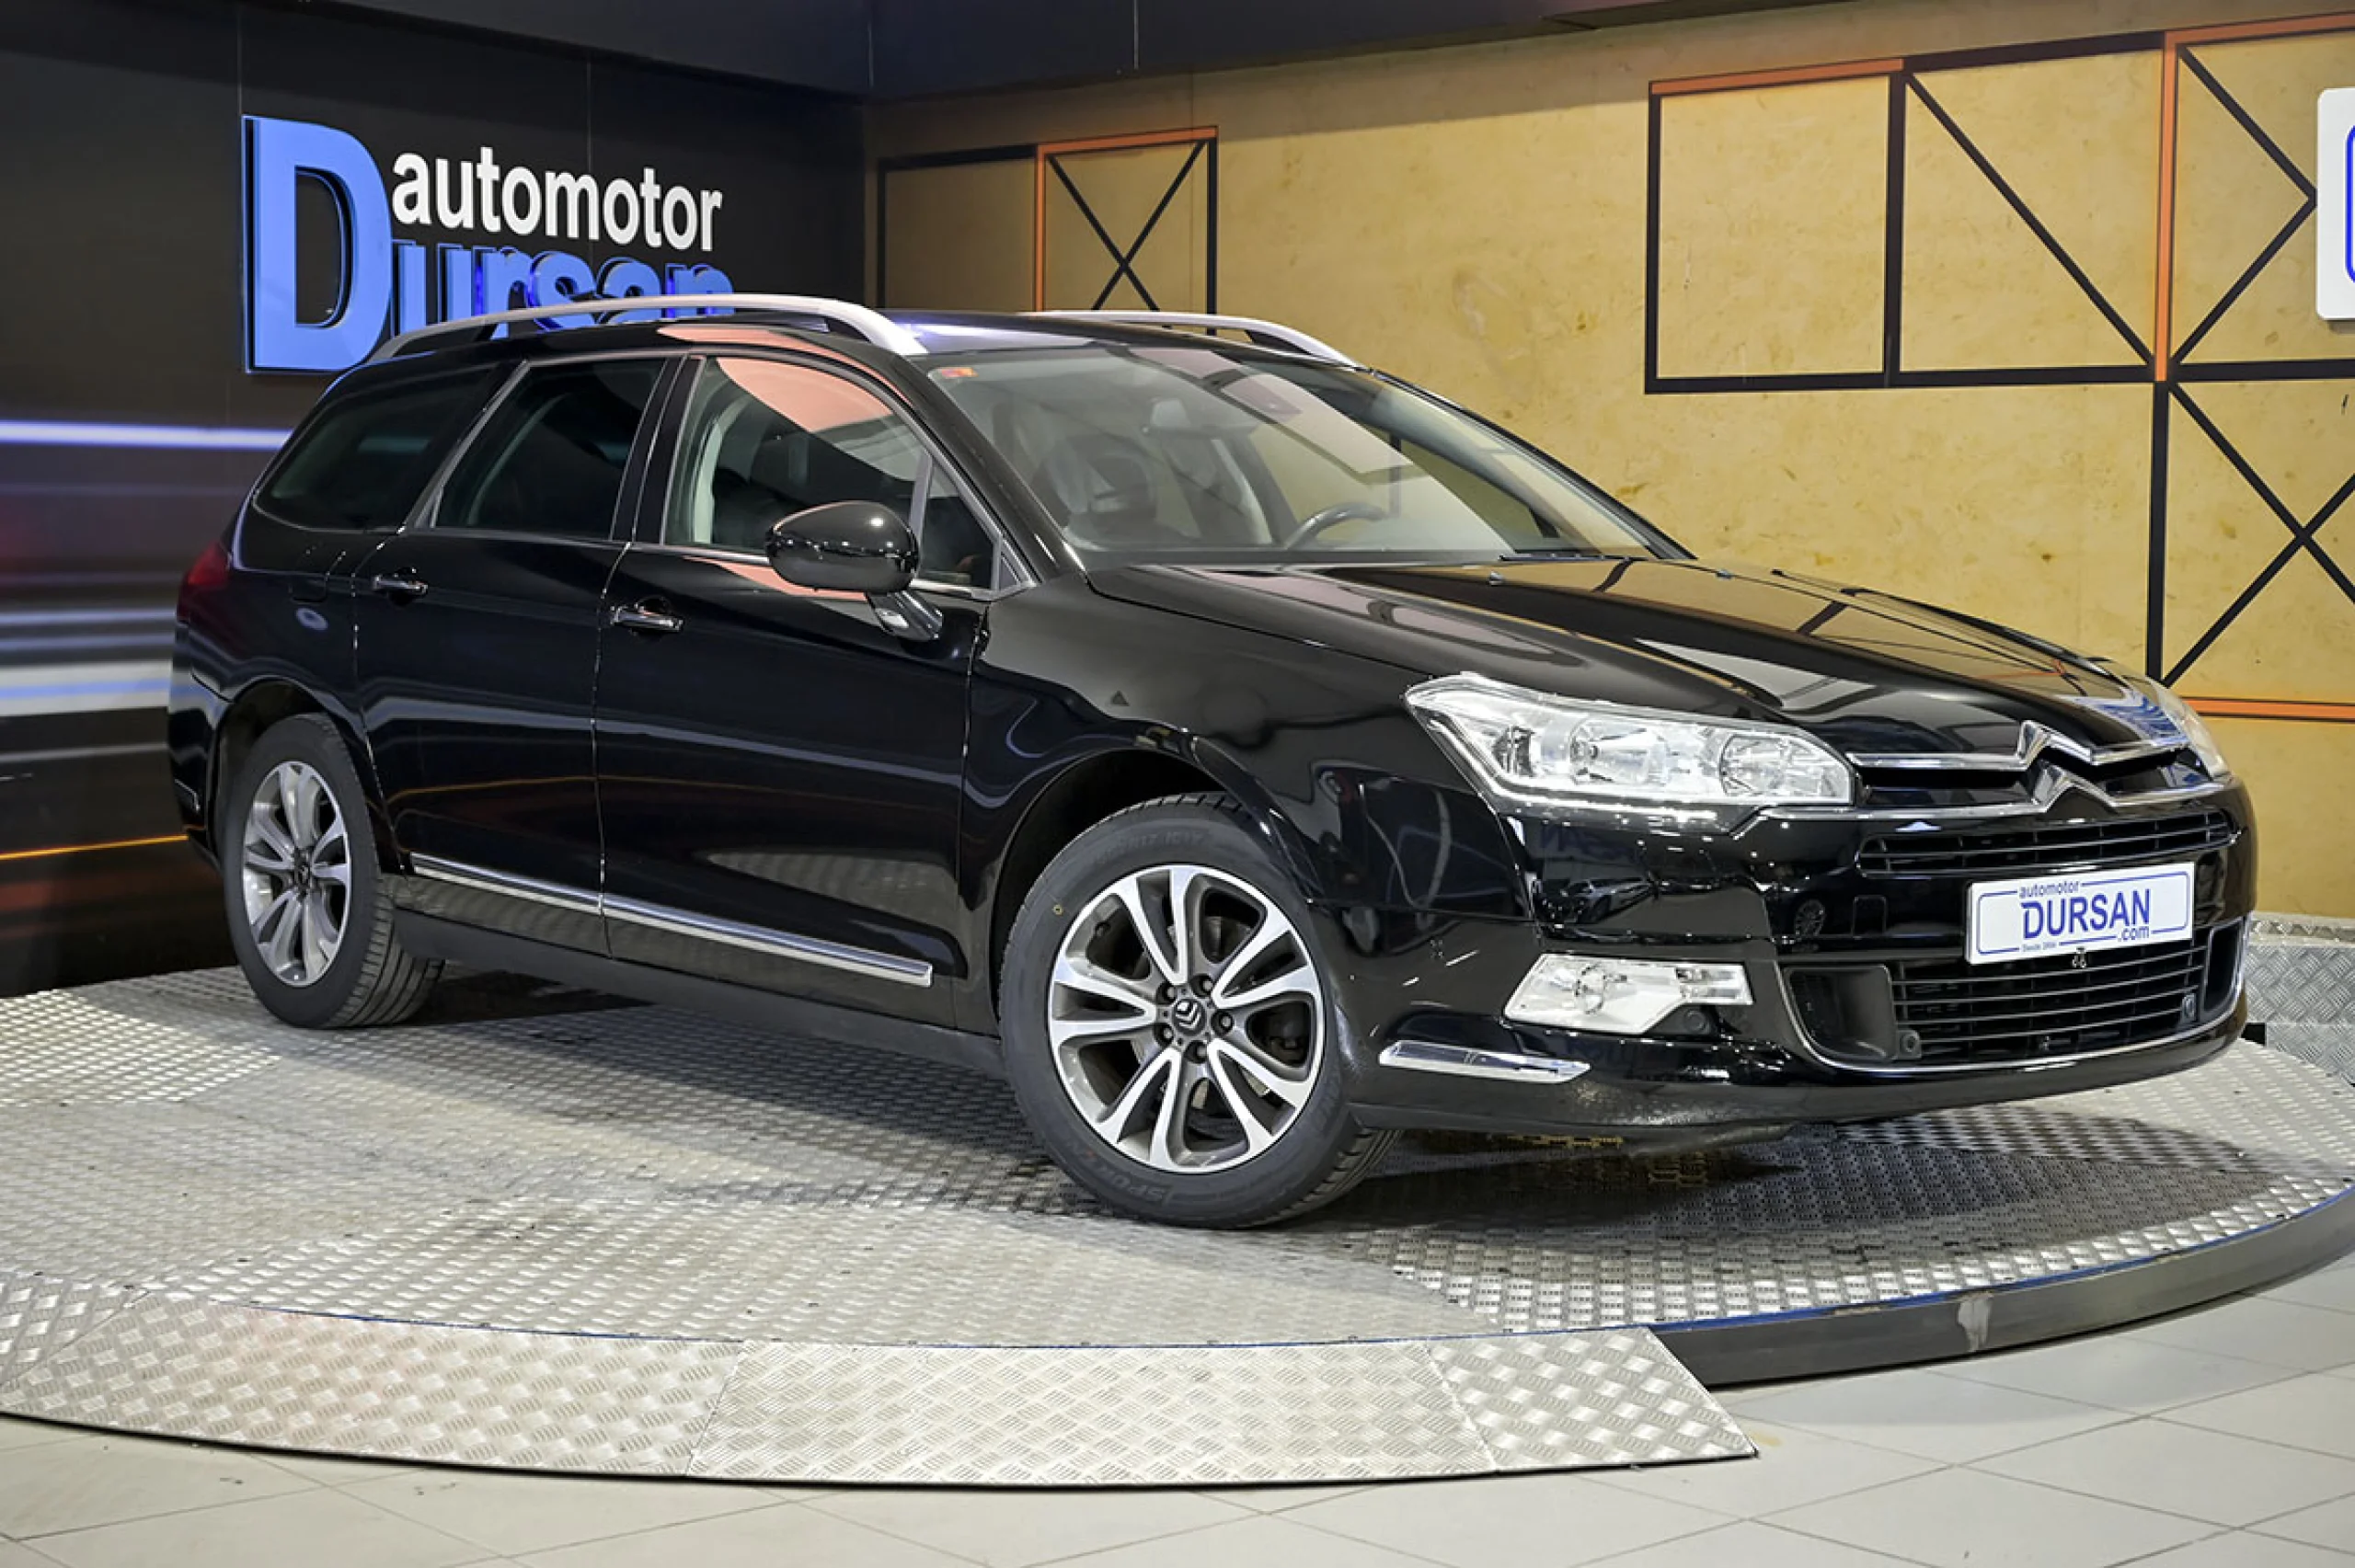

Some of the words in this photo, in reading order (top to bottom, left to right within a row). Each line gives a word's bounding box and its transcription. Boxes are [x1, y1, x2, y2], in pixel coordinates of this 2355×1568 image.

[392, 146, 723, 252] automotor
[2018, 880, 2080, 899] automotor
[2020, 888, 2151, 940] DURSAN
[2117, 925, 2150, 943] .com
